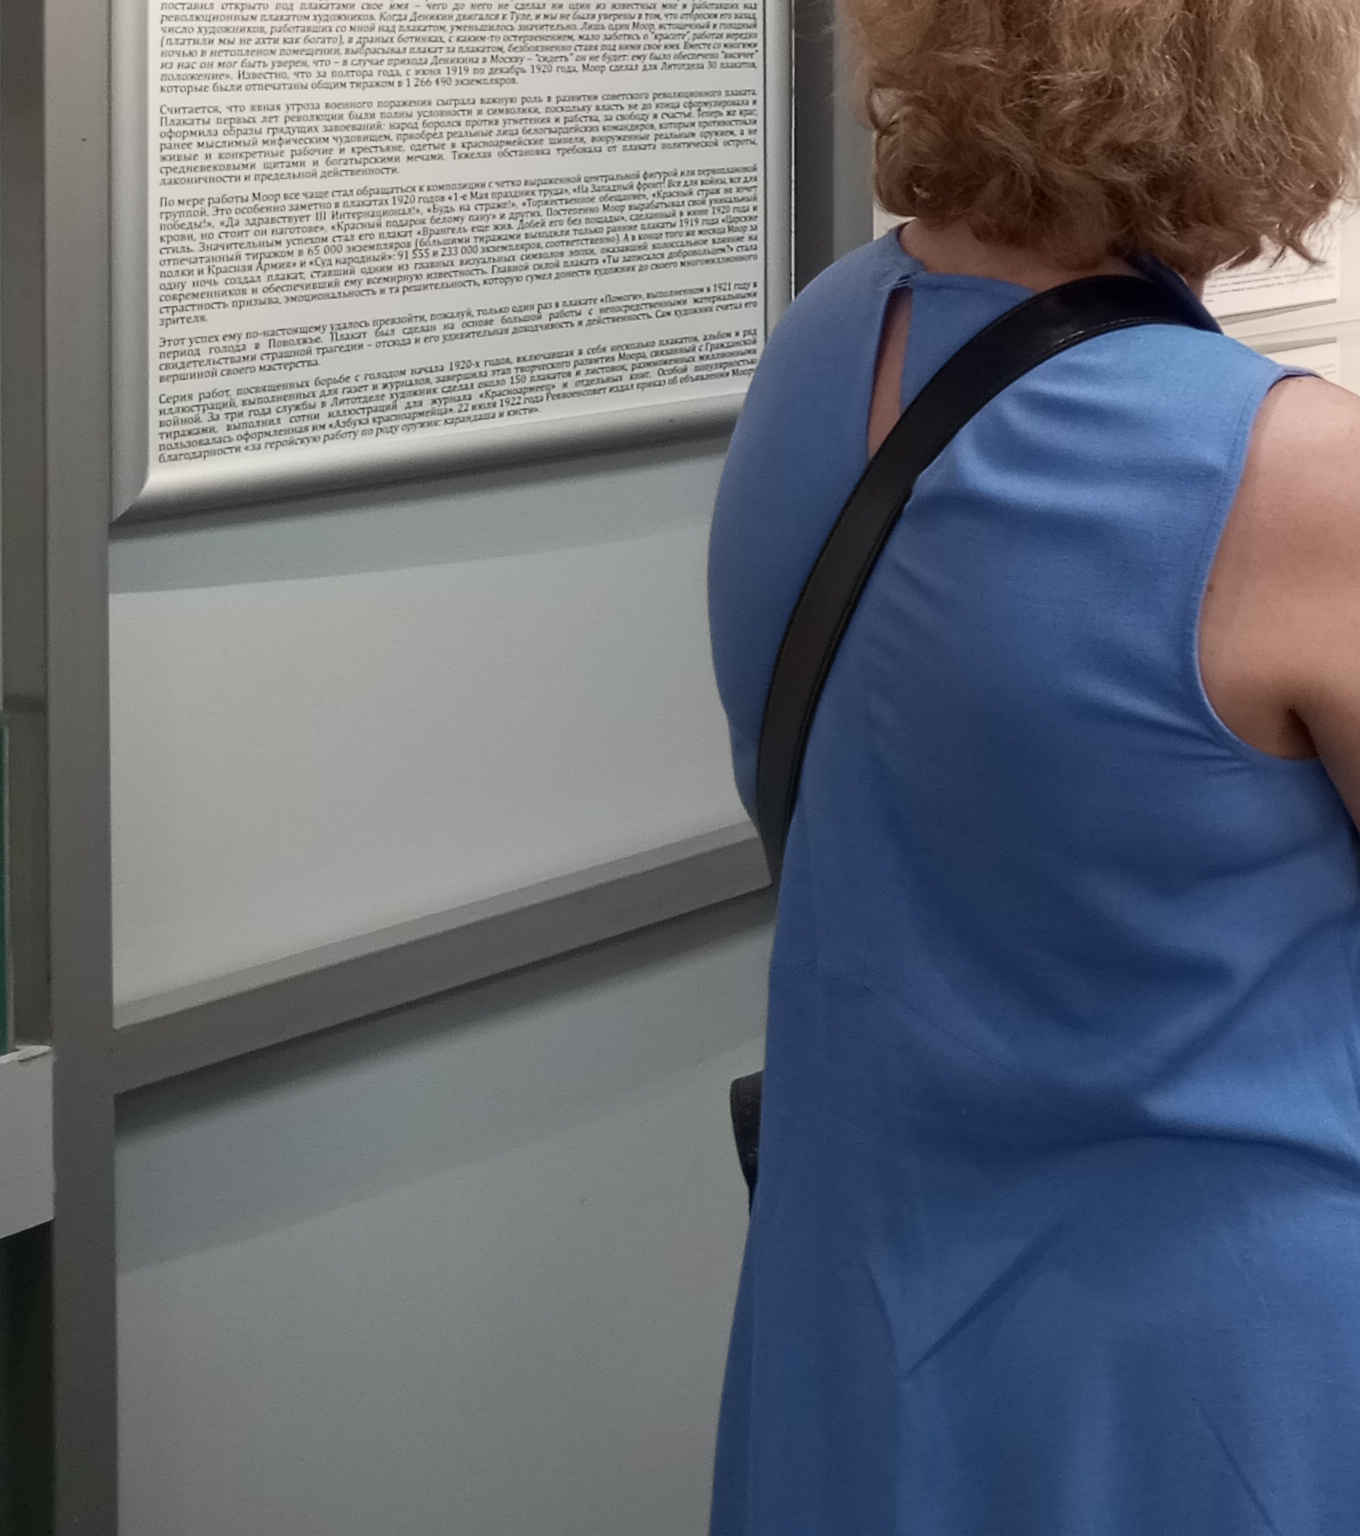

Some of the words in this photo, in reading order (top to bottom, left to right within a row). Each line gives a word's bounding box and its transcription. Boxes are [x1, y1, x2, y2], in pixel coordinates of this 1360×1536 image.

[160, 83, 210, 96] которые
[211, 81, 242, 92] были
[244, 81, 309, 91] отпечатаны
[225, 103, 246, 113] что
[160, 114, 211, 127] Плакаты
[215, 115, 257, 127] первых
[160, 152, 199, 163] живые
[217, 148, 285, 162] конкретные
[160, 173, 241, 186] лаконичности
[177, 196, 205, 209] мере
[207, 192, 249, 207] работы
[251, 190, 281, 205] Моор
[211, 204, 232, 216] Это
[234, 201, 286, 215] особенно
[198, 236, 282, 252] Значительным
[160, 267, 195, 279] полки
[206, 261, 253, 278] Красная
[159, 286, 247, 305] современников
[159, 334, 186, 348] Этот
[187, 333, 219, 347] успех
[221, 331, 243, 344] ему
[159, 366, 218, 386] вершиной
[219, 364, 256, 377] своего
[159, 390, 193, 407] Серия
[223, 409, 244, 423] три
[247, 406, 272, 419] года
[159, 433, 234, 452] пользовалась
[158, 442, 241, 467] благодарности
